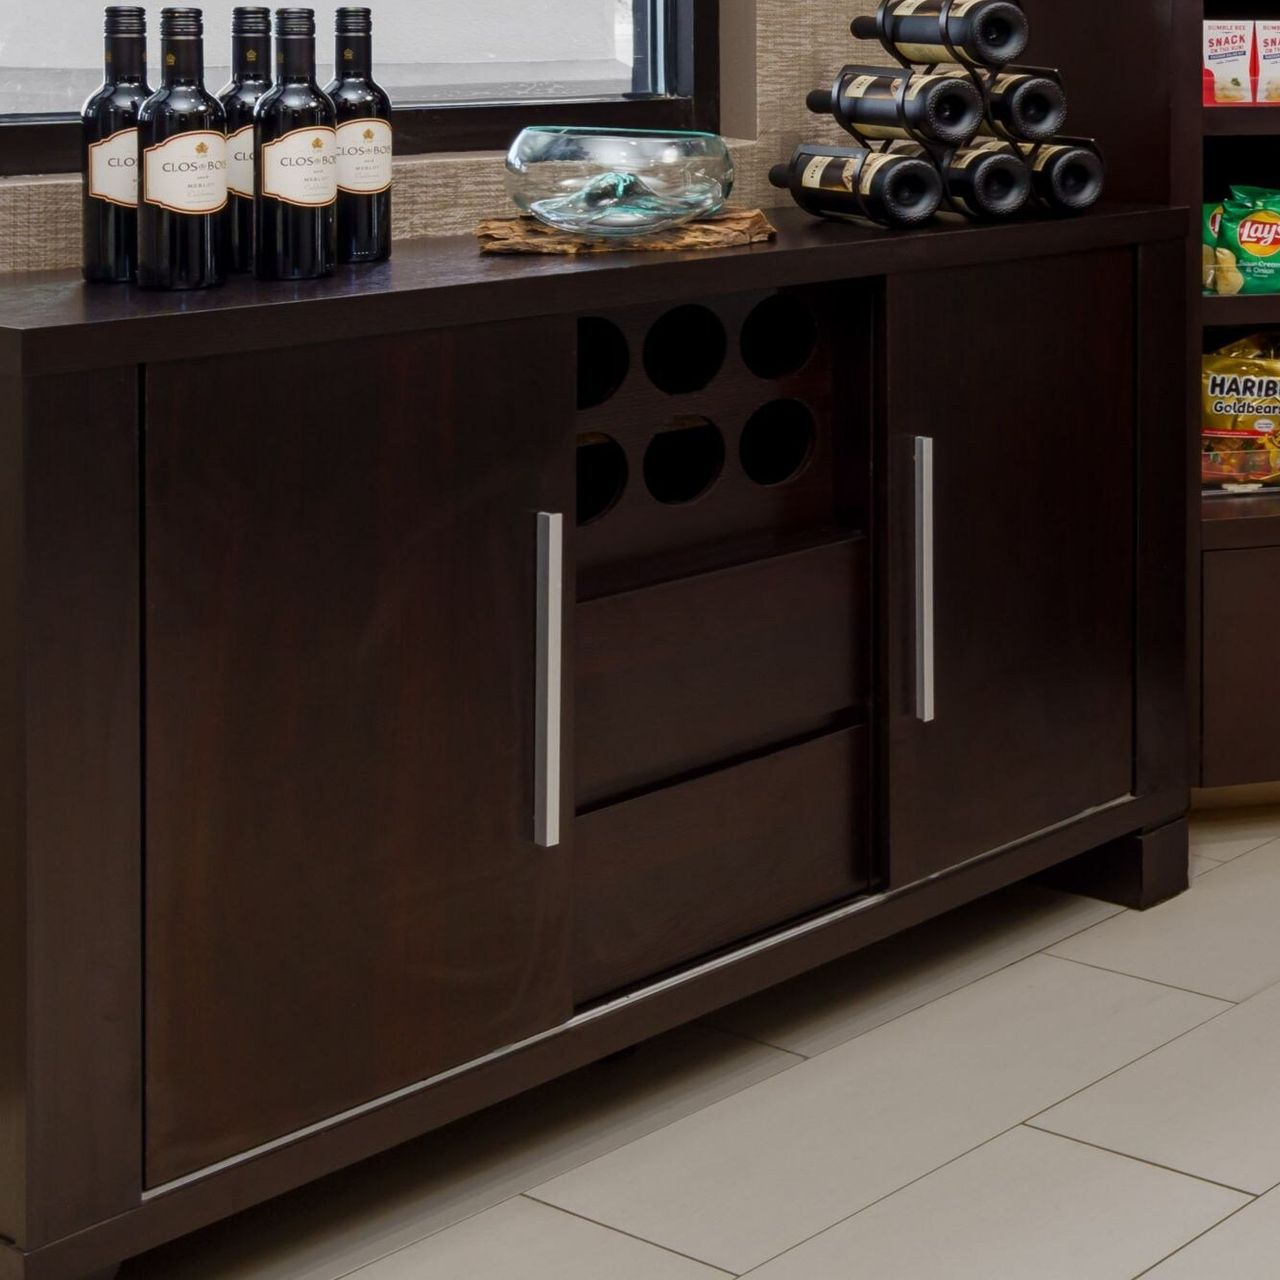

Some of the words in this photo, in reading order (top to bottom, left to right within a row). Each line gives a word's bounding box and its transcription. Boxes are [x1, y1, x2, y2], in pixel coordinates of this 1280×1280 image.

[1208, 34, 1246, 48] SNACK
[107, 157, 138, 167] CLO
[280, 156, 313, 167] CLOS
[162, 162, 197, 173] CLOS
